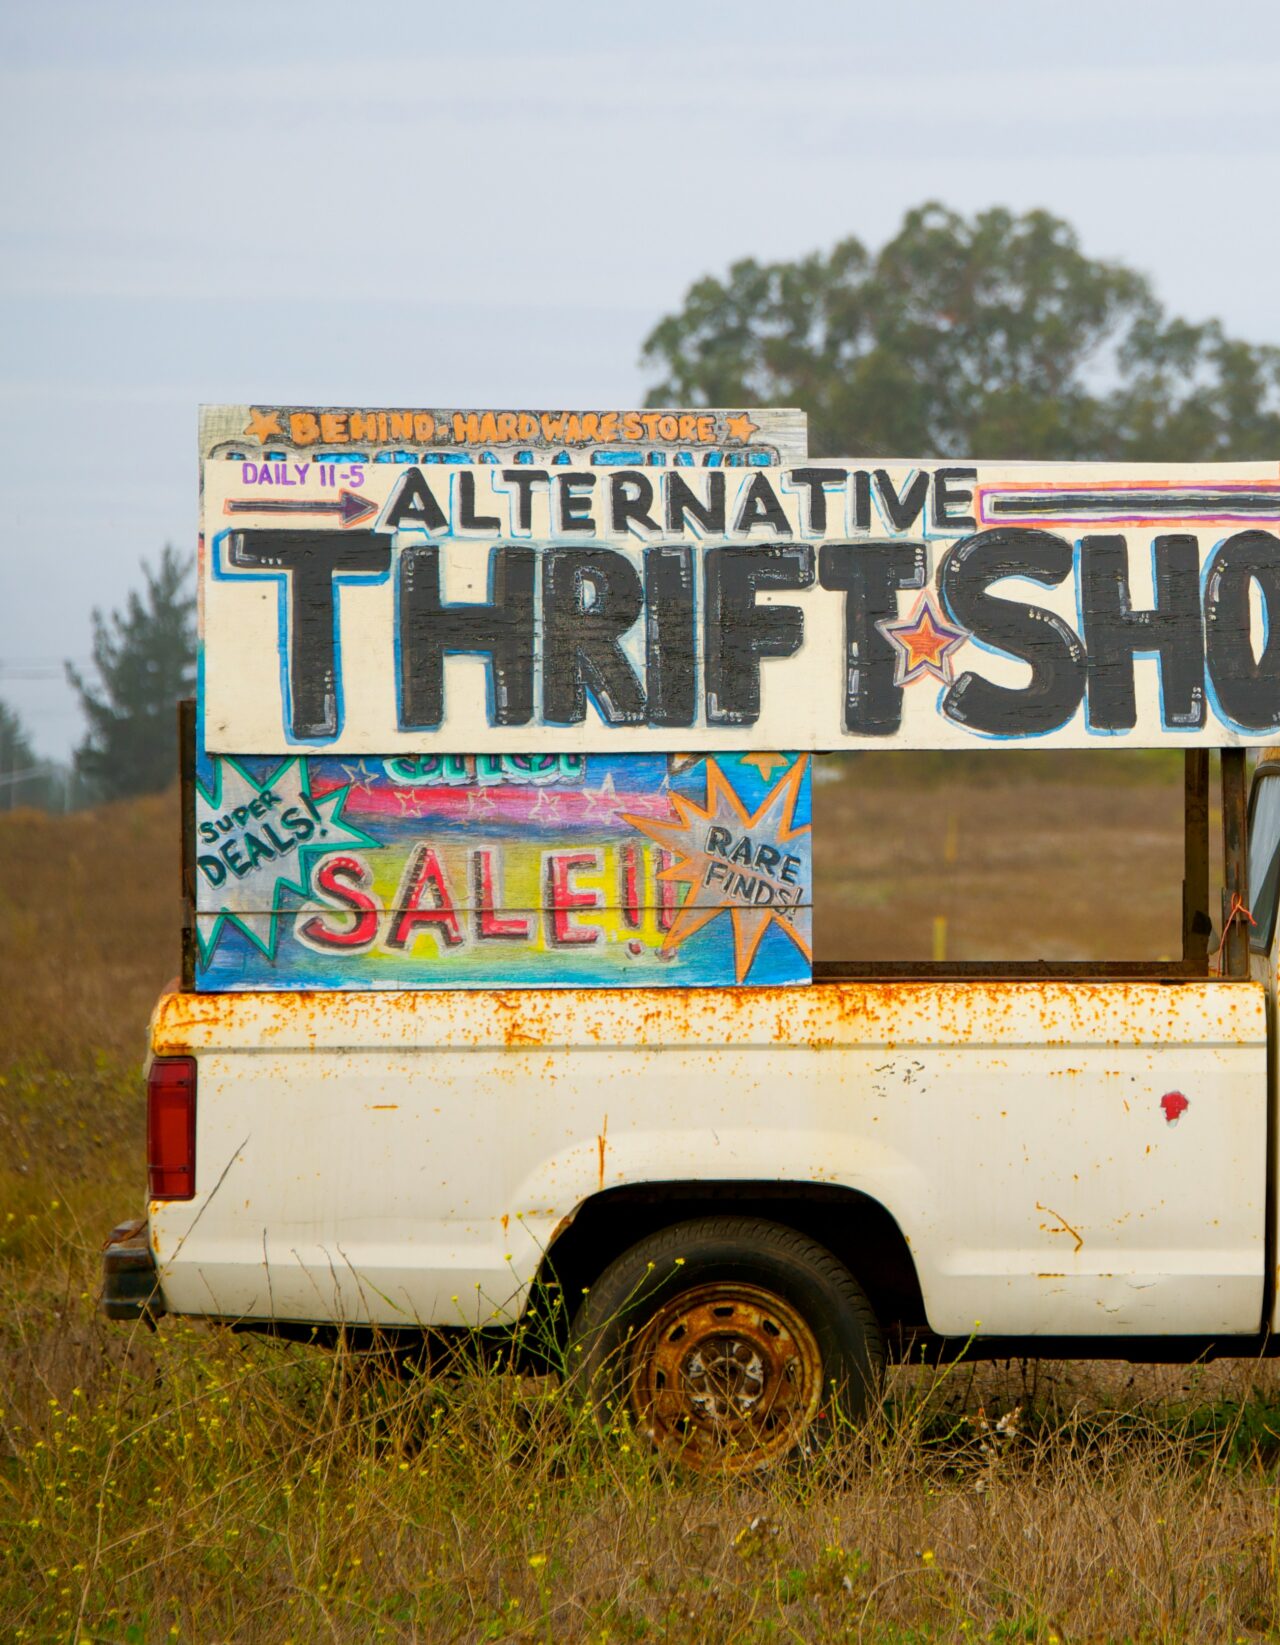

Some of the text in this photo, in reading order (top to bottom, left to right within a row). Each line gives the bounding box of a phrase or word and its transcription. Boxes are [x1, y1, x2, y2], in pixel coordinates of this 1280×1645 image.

[623, 411, 717, 442] STORE
[242, 462, 365, 488] DAILY 11-5
[375, 467, 979, 541] ALTERNATIVE
[213, 527, 929, 745] THRIFT
[197, 791, 328, 890] DEALS!
[198, 790, 282, 844] SUPER
[704, 826, 802, 888] RARE
[702, 861, 804, 926] FINDS!
